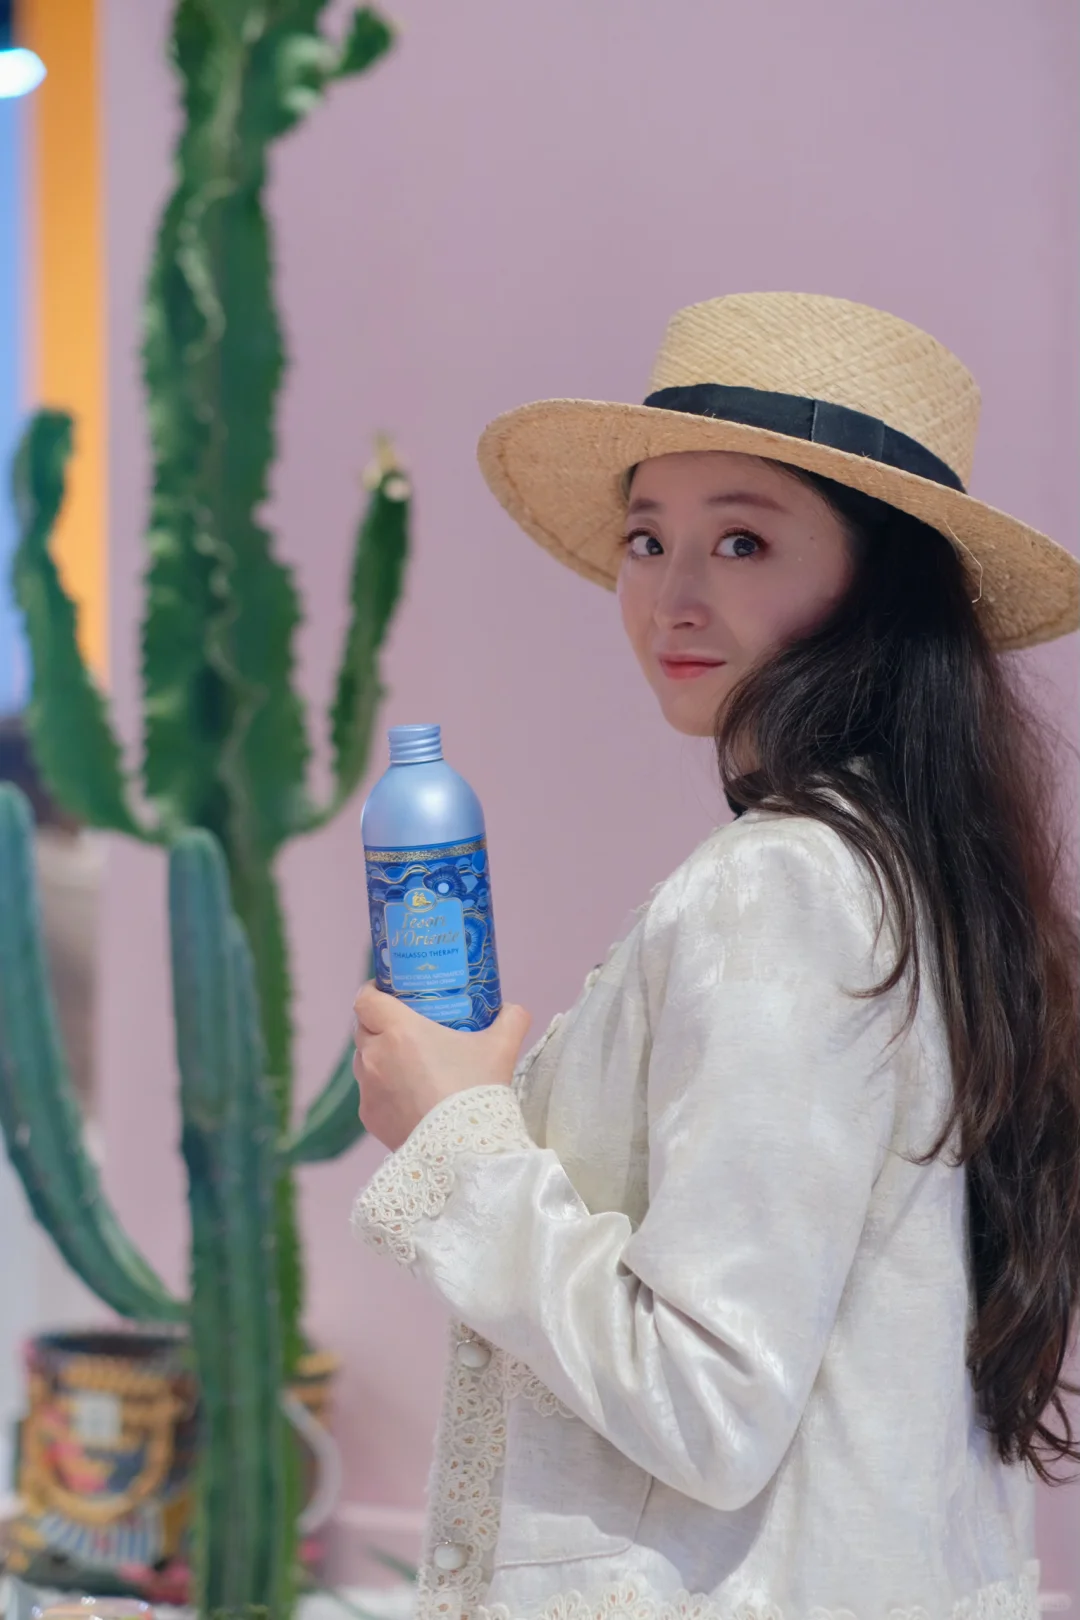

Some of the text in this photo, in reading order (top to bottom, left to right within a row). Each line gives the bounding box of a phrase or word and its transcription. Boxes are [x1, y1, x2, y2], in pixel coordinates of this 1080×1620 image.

[402, 912, 446, 929] Tesori
[391, 929, 460, 947] d'Oriente
[392, 948, 460, 959] THALASSO THERAPY
